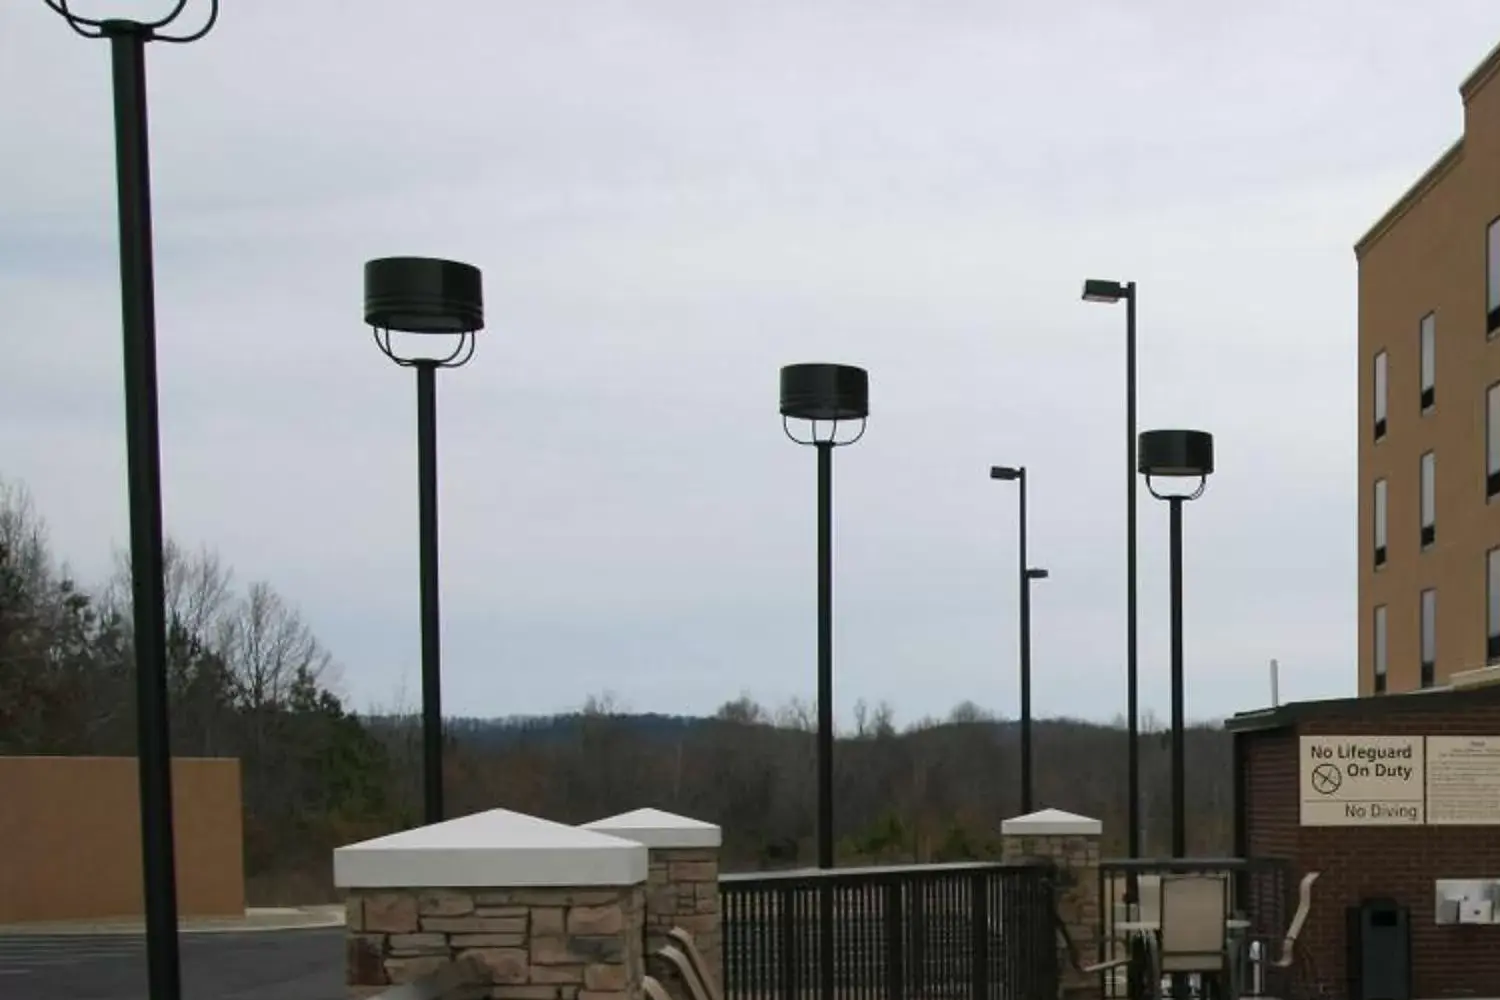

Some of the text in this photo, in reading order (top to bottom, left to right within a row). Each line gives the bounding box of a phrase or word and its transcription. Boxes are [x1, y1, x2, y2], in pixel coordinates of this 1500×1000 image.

[1311, 744, 1412, 762] No Lifeguard
[1347, 763, 1412, 781] On Duty
[1345, 803, 1417, 821] No Diving
